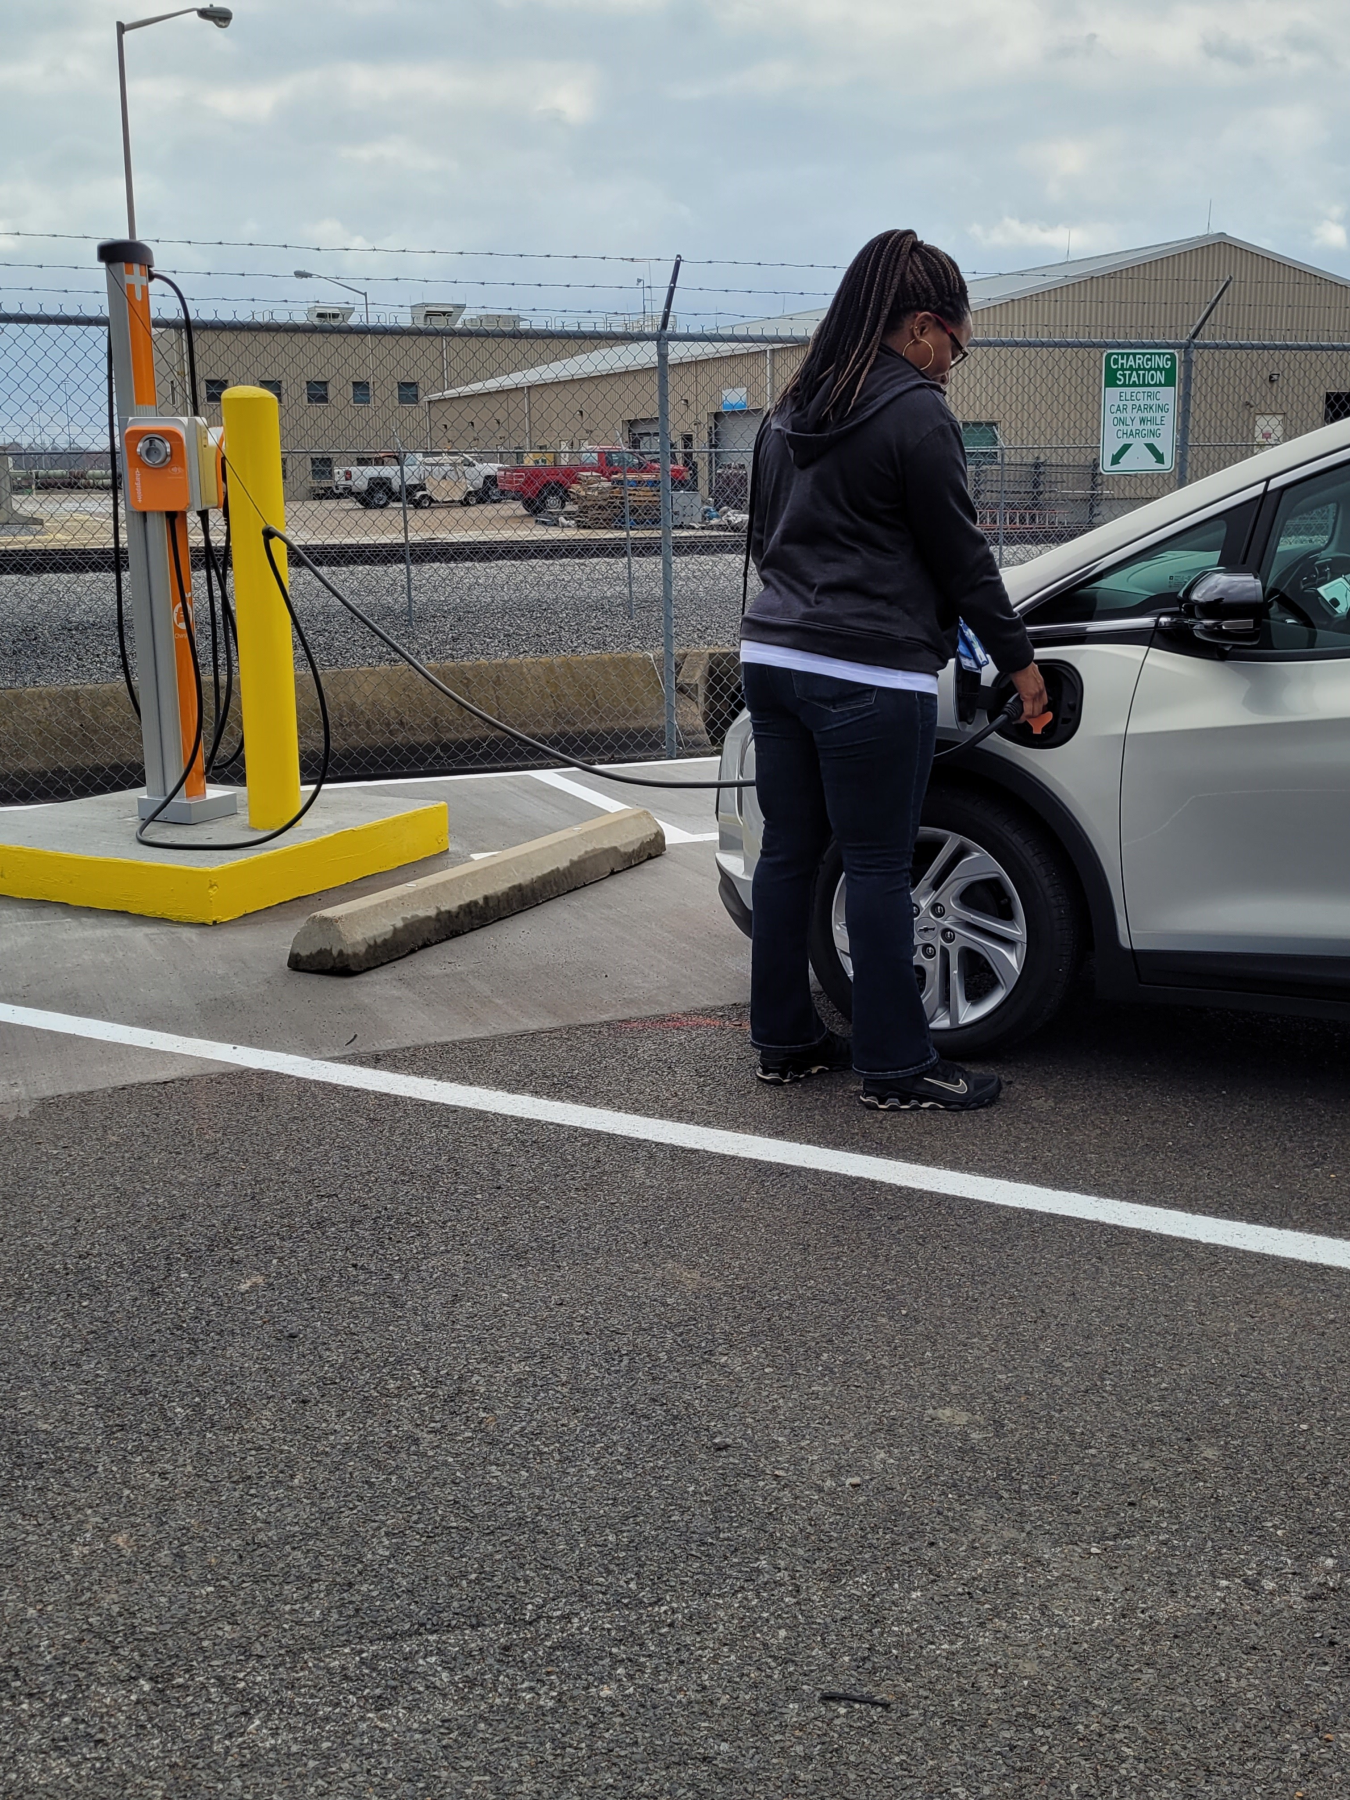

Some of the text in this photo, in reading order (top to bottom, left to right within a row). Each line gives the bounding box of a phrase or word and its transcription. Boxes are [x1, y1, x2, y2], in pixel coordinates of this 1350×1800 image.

[1110, 354, 1171, 369] CHARGING
[1116, 370, 1165, 385] STATION
[1119, 391, 1161, 402] ELECTRIC
[1109, 403, 1170, 414] CAR PARKING
[1112, 415, 1166, 427] ONLY WHILE
[1116, 428, 1162, 439] CHARGING
